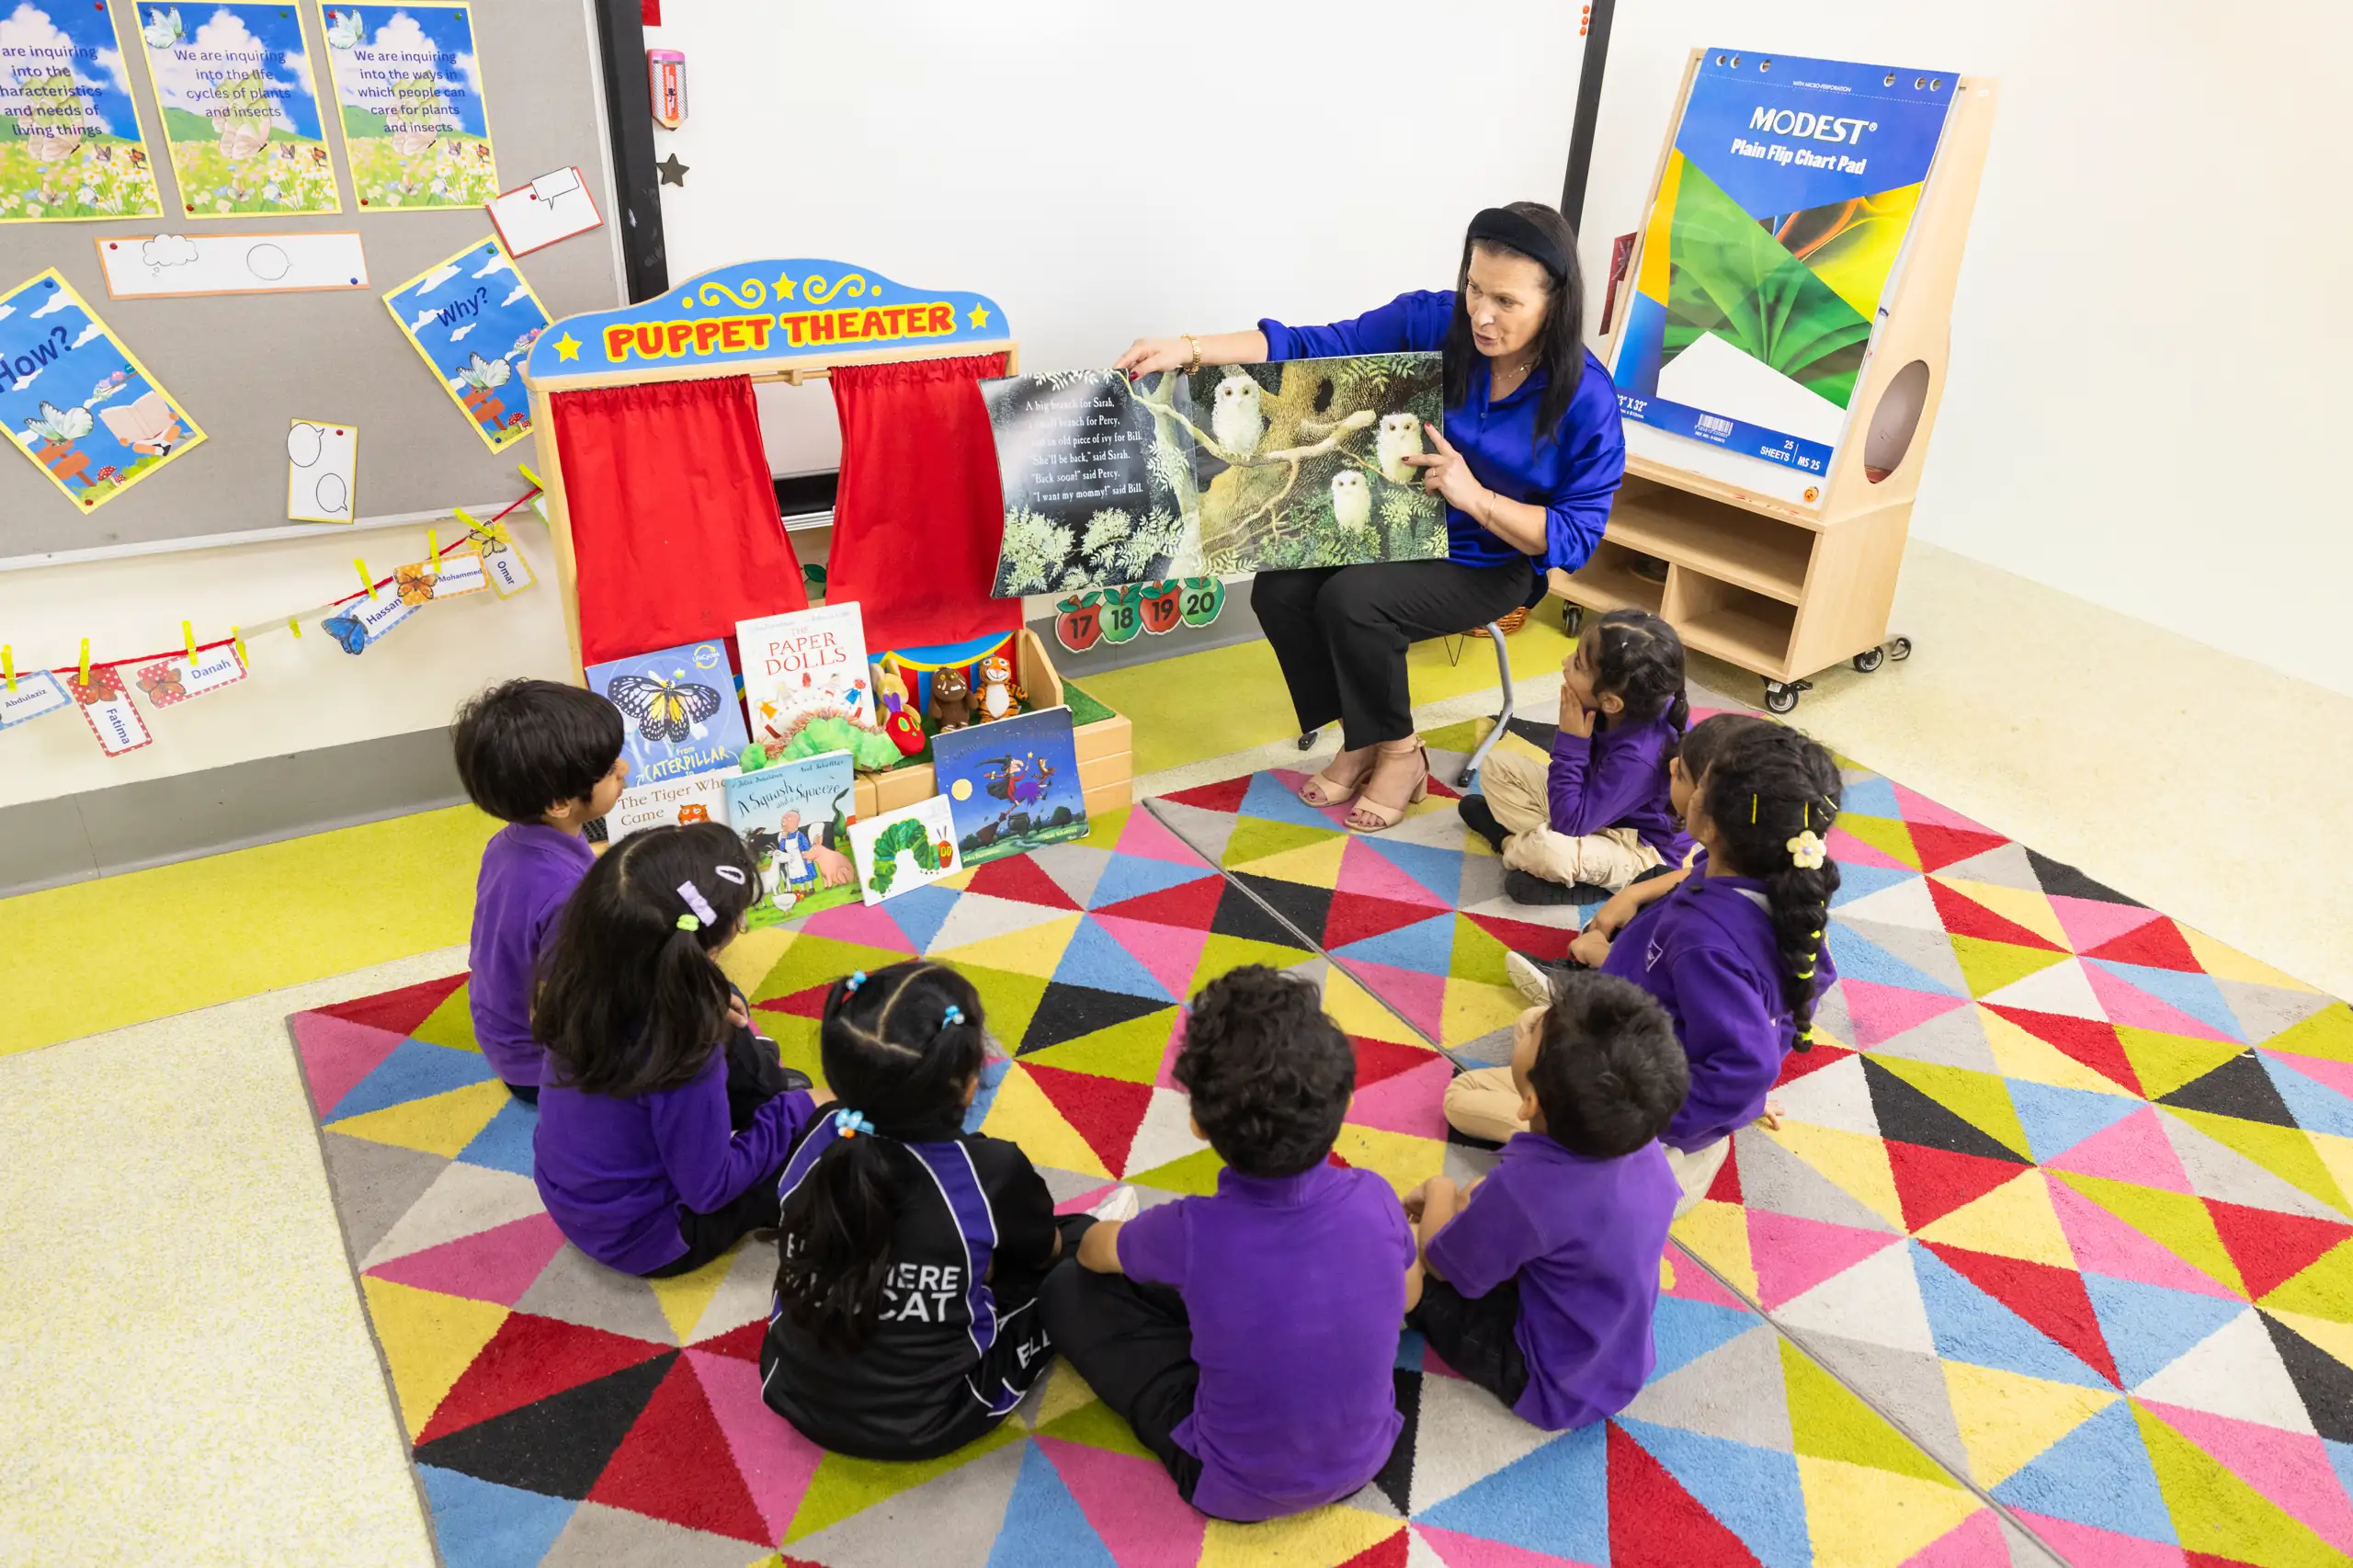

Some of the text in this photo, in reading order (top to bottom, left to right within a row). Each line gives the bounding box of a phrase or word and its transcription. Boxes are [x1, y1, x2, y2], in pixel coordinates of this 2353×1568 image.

[2, 45, 98, 60] are inquiring
[174, 50, 287, 64] We are inquiring
[354, 51, 457, 64] We are inquiring
[11, 65, 71, 77] into the
[195, 69, 274, 80] into the life
[359, 69, 458, 82] into the ways in
[0, 85, 103, 97] haracteristics
[187, 87, 291, 101] cycles of plants
[358, 86, 466, 99] which people can
[5, 104, 100, 117] and needs of
[206, 107, 281, 117] and insects
[370, 105, 460, 117] care for plants
[12, 124, 103, 138] living things
[384, 122, 453, 132] and insects
[1730, 138, 1868, 175] Plain Flip Chart Pad
[436, 286, 488, 327] Why?
[605, 304, 956, 360] PUPPET THEATER
[0, 325, 72, 393] How?
[1026, 401, 1033, 411] A
[1036, 399, 1049, 413] big
[1079, 398, 1091, 408] for
[1094, 396, 1115, 408] Sarah,
[1059, 416, 1085, 427] branch
[1086, 415, 1097, 426] for
[1058, 435, 1071, 446] old
[1073, 435, 1090, 448] piece
[1092, 434, 1100, 444] of
[1101, 434, 1112, 445] ivy
[1114, 432, 1125, 443] for
[1784, 439, 1794, 449] 25
[1059, 453, 1068, 464] be
[1092, 449, 1107, 461] said
[1108, 449, 1131, 460] Sarah.
[1759, 446, 1821, 471] SHEETS MS 25
[1083, 469, 1097, 480] said
[1098, 468, 1120, 480] Percy.
[1042, 492, 1060, 501] want
[1063, 492, 1074, 503] my
[1112, 484, 1126, 494] said
[1128, 483, 1143, 494] Bill.
[438, 568, 483, 583] Mohammed
[496, 561, 516, 585] Omar
[366, 597, 403, 625] Hassan
[1070, 591, 1215, 639] 17 18 19 20
[768, 631, 835, 656] PAPER
[765, 647, 847, 676] DOLLS
[190, 660, 232, 680] Danah
[5, 688, 48, 708] Abdulaziz
[106, 708, 131, 744] Fatima
[676, 746, 695, 756] From
[644, 746, 729, 782] CATERPILLAR
[618, 796, 647, 810] The
[651, 786, 691, 802] Tiger
[737, 778, 794, 818] A Squash
[796, 783, 841, 803] Squeeze
[621, 809, 664, 826] Came
